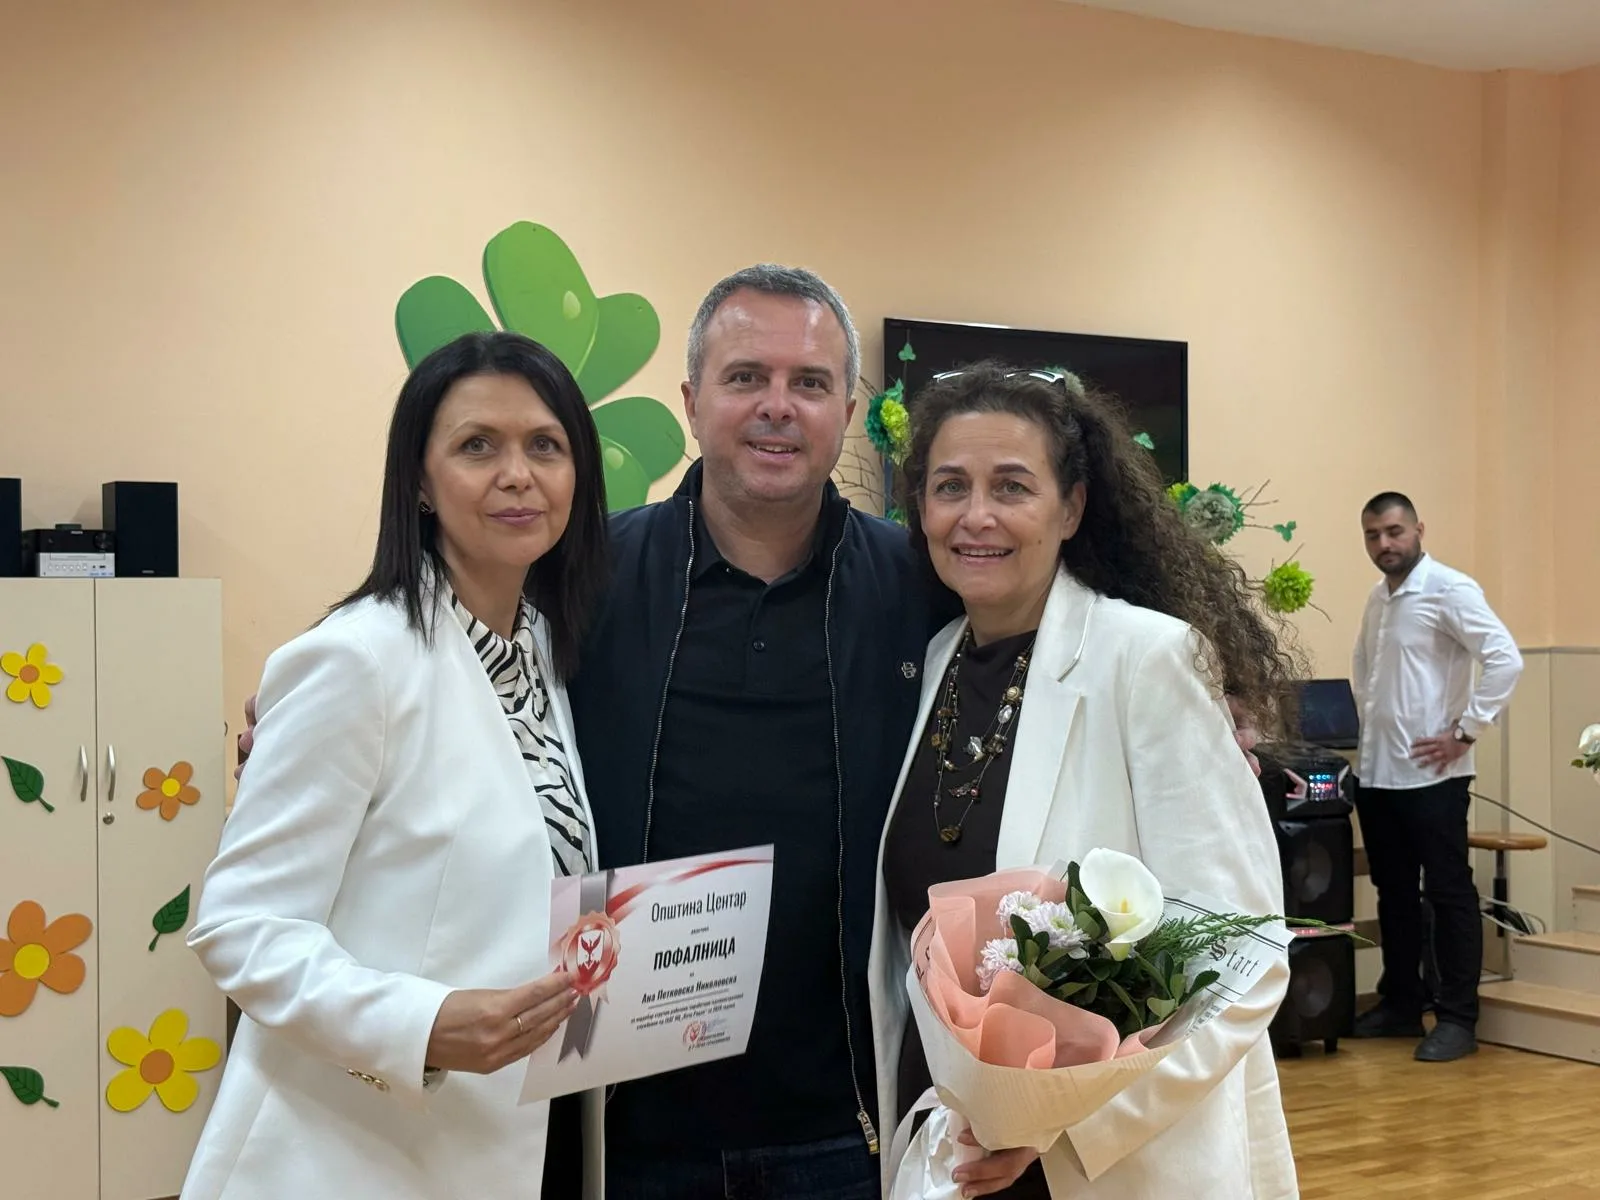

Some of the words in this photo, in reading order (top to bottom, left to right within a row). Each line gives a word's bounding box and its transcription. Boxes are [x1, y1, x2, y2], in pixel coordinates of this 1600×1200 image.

[651, 898, 703, 922] Општина
[705, 890, 747, 914] Центар
[653, 936, 736, 971] ПОФАЛНИЦА
[1209, 936, 1259, 977] Start
[641, 993, 656, 1005] Ана
[657, 986, 694, 1001] Петковска
[695, 975, 738, 992] Николовска
